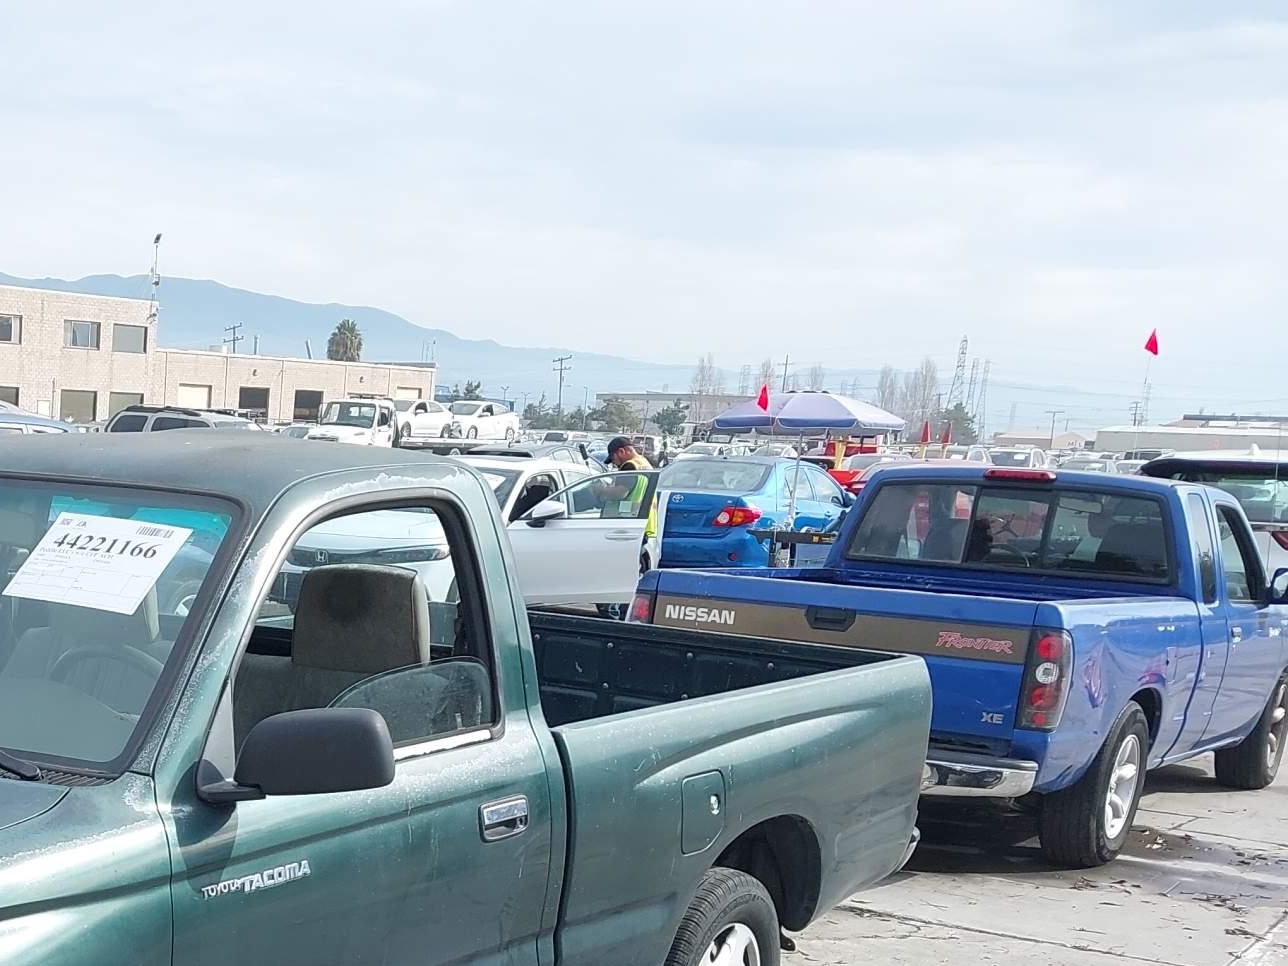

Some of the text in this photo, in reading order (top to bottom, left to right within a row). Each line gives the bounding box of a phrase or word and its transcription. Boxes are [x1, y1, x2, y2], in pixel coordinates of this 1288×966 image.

[53, 532, 163, 559] 44221166
[665, 604, 736, 625] NISSAN
[935, 631, 1014, 654] FRONTIER
[980, 711, 1005, 724] XE
[201, 859, 312, 900] TOYOTA TACOMA
